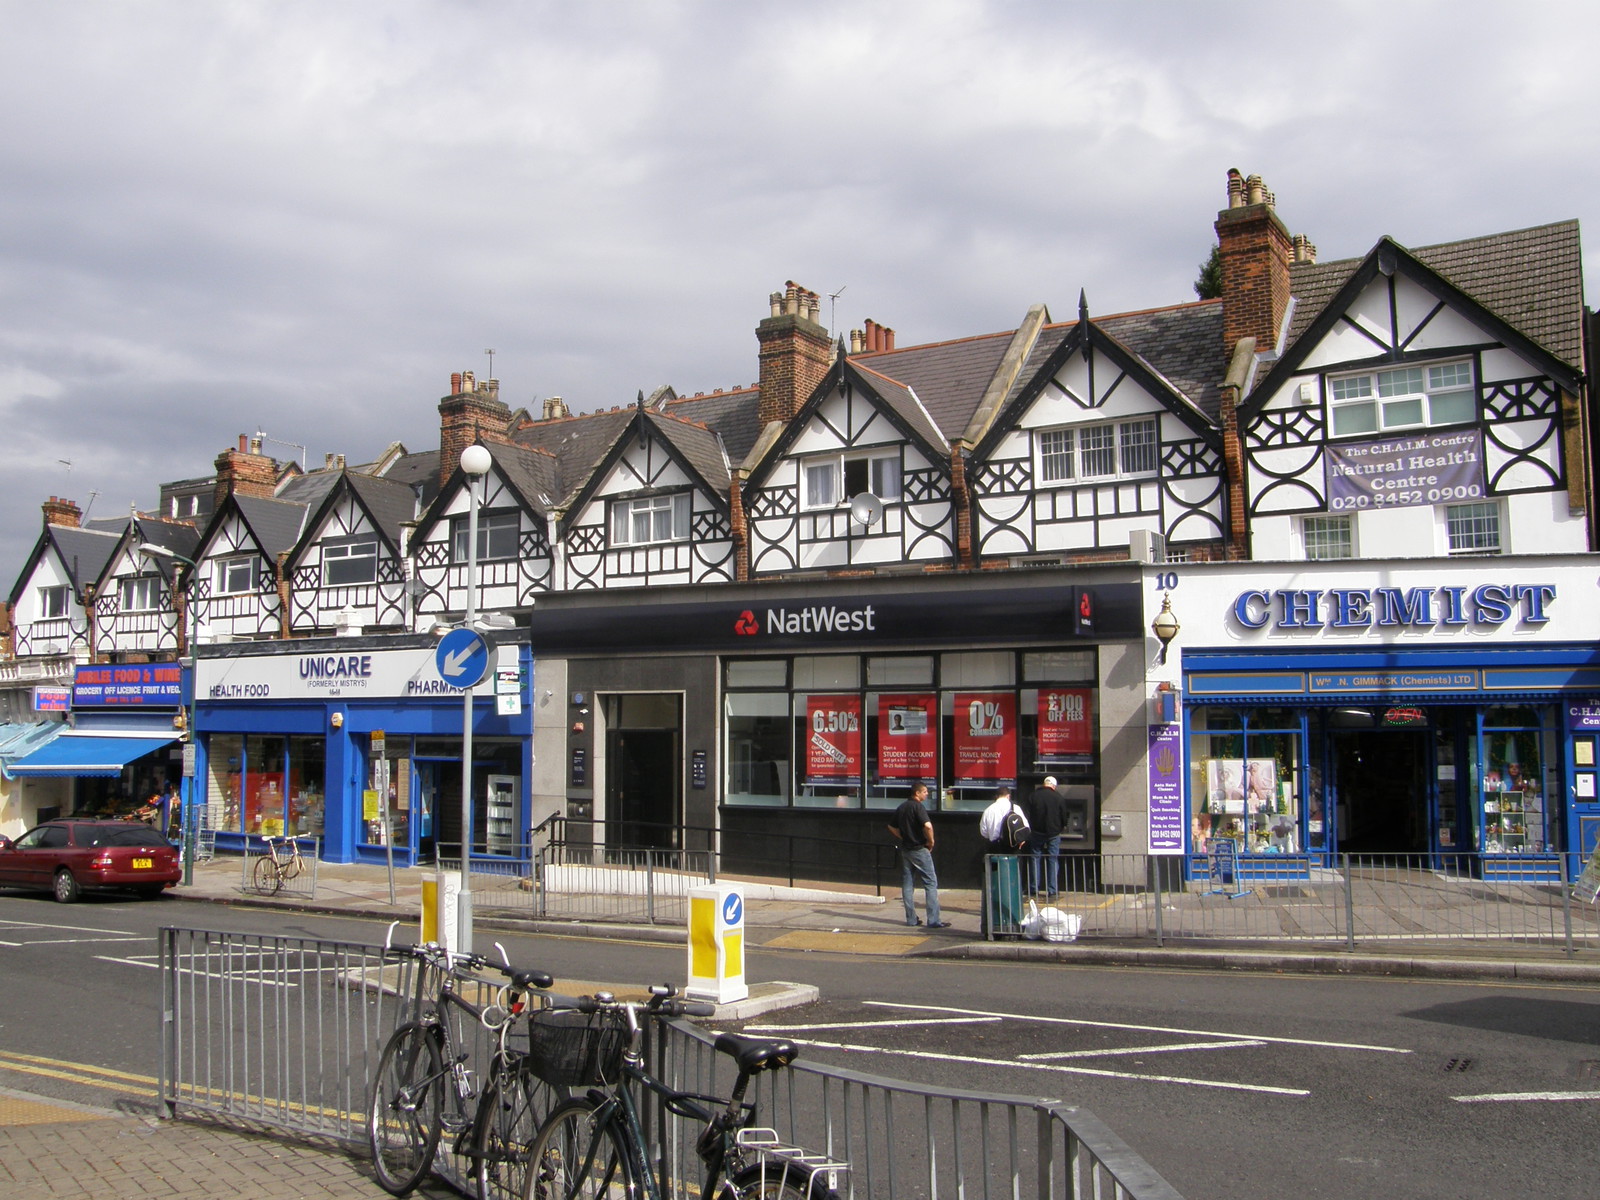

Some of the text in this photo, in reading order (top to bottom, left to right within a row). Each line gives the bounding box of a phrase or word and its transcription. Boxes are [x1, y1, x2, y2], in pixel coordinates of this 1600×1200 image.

[1345, 435, 1475, 457] The C.H.A.I.M. Centre
[1332, 450, 1477, 477] Natural Health
[1370, 475, 1438, 491] Centre
[1332, 484, 1480, 510] 020 8452 0900
[1155, 572, 1178, 590] 10
[1235, 584, 1557, 628] CHEMIST
[767, 605, 875, 634] NatWest
[76, 668, 181, 684] JUBILEE FOOD & WINE
[300, 656, 372, 678] UNICARE
[307, 679, 367, 688] (FORMERLY MISTRYS)
[1353, 677, 1398, 686] GIMMACK
[1401, 676, 1451, 685] (Chemists)
[1454, 675, 1471, 684] LTD
[76, 686, 102, 695] GROCERY
[104, 687, 116, 695] OFF
[117, 686, 142, 694] LICENCE
[143, 686, 160, 694] FRUIT
[160, 686, 165, 694] &
[209, 684, 269, 697] HEALTH FOOD
[1048, 693, 1083, 711] £100
[970, 701, 1003, 730] 0%
[1048, 710, 1084, 721] OFF FEES
[1386, 708, 1423, 720] OPEN
[969, 728, 1004, 736] COMMISSION
[814, 735, 845, 761] SOLD OUT
